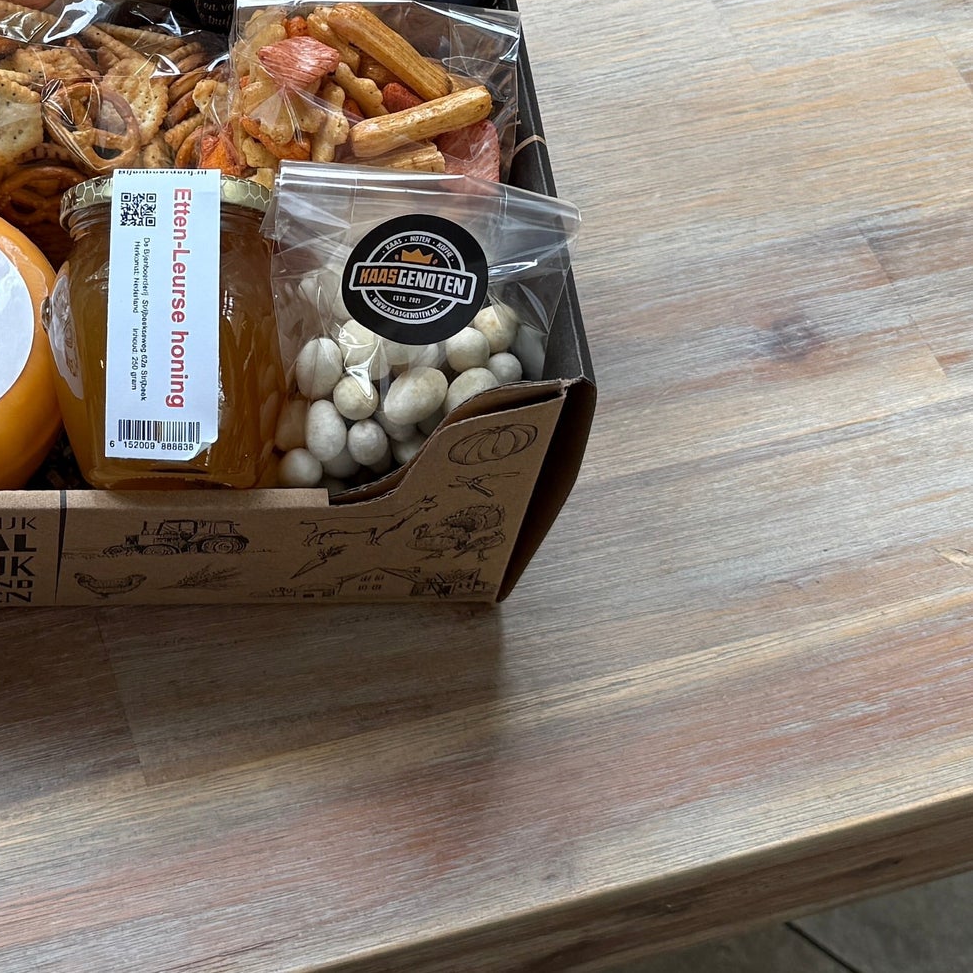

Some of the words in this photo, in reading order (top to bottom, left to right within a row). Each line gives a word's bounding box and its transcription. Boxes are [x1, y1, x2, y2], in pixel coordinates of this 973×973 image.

[170, 188, 192, 324] Etten-Leurse
[385, 238, 403, 250] KAAS
[409, 235, 431, 244] NOTEN
[359, 268, 467, 296] KAASGENOTEN
[165, 330, 190, 408] honing
[109, 440, 115, 448] 6
[123, 441, 156, 450] 152009
[160, 443, 194, 451] 888838
